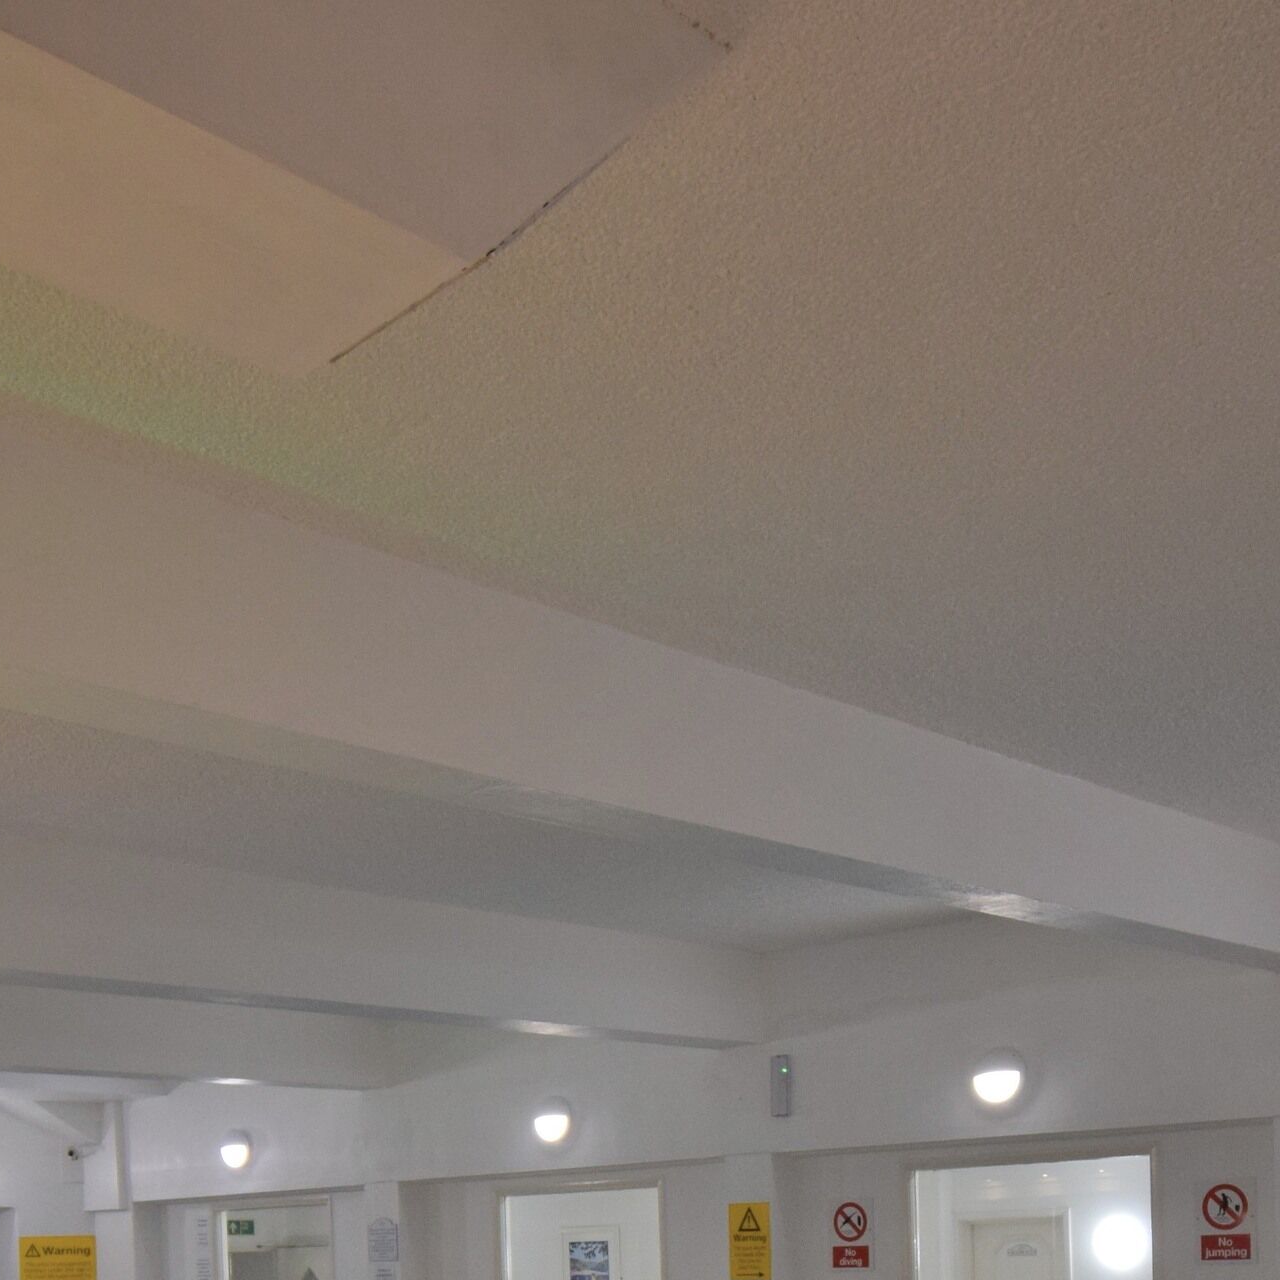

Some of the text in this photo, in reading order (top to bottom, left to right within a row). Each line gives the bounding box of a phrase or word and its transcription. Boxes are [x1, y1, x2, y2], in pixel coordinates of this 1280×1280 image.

[733, 1234, 767, 1244] Warning
[1218, 1237, 1233, 1246] No
[42, 1246, 91, 1257] Warning
[845, 1248, 856, 1256] No
[1205, 1248, 1247, 1259] jumping
[840, 1257, 862, 1266] diving
